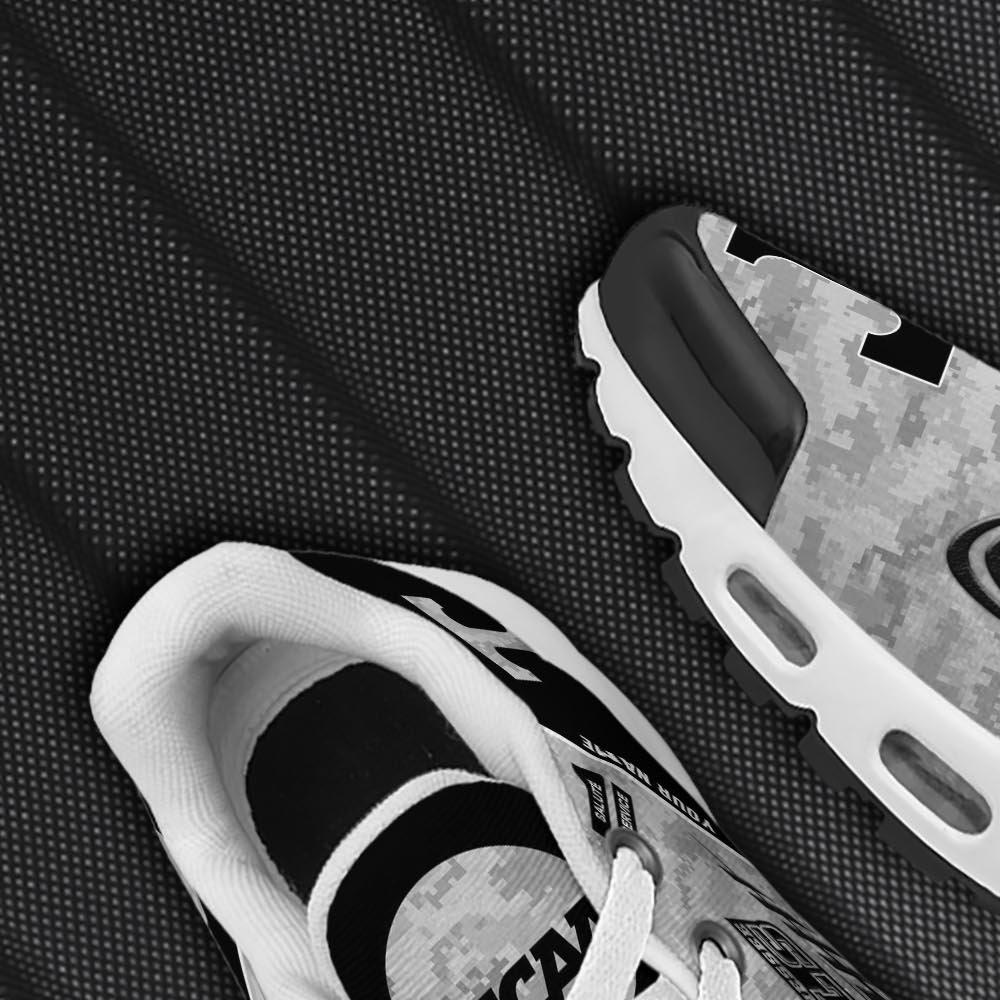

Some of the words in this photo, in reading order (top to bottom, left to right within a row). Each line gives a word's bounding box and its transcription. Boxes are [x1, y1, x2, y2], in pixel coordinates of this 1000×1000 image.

[586, 778, 607, 823] SALUTE
[616, 791, 634, 831] ERVICE
[658, 783, 717, 834] YOUR
